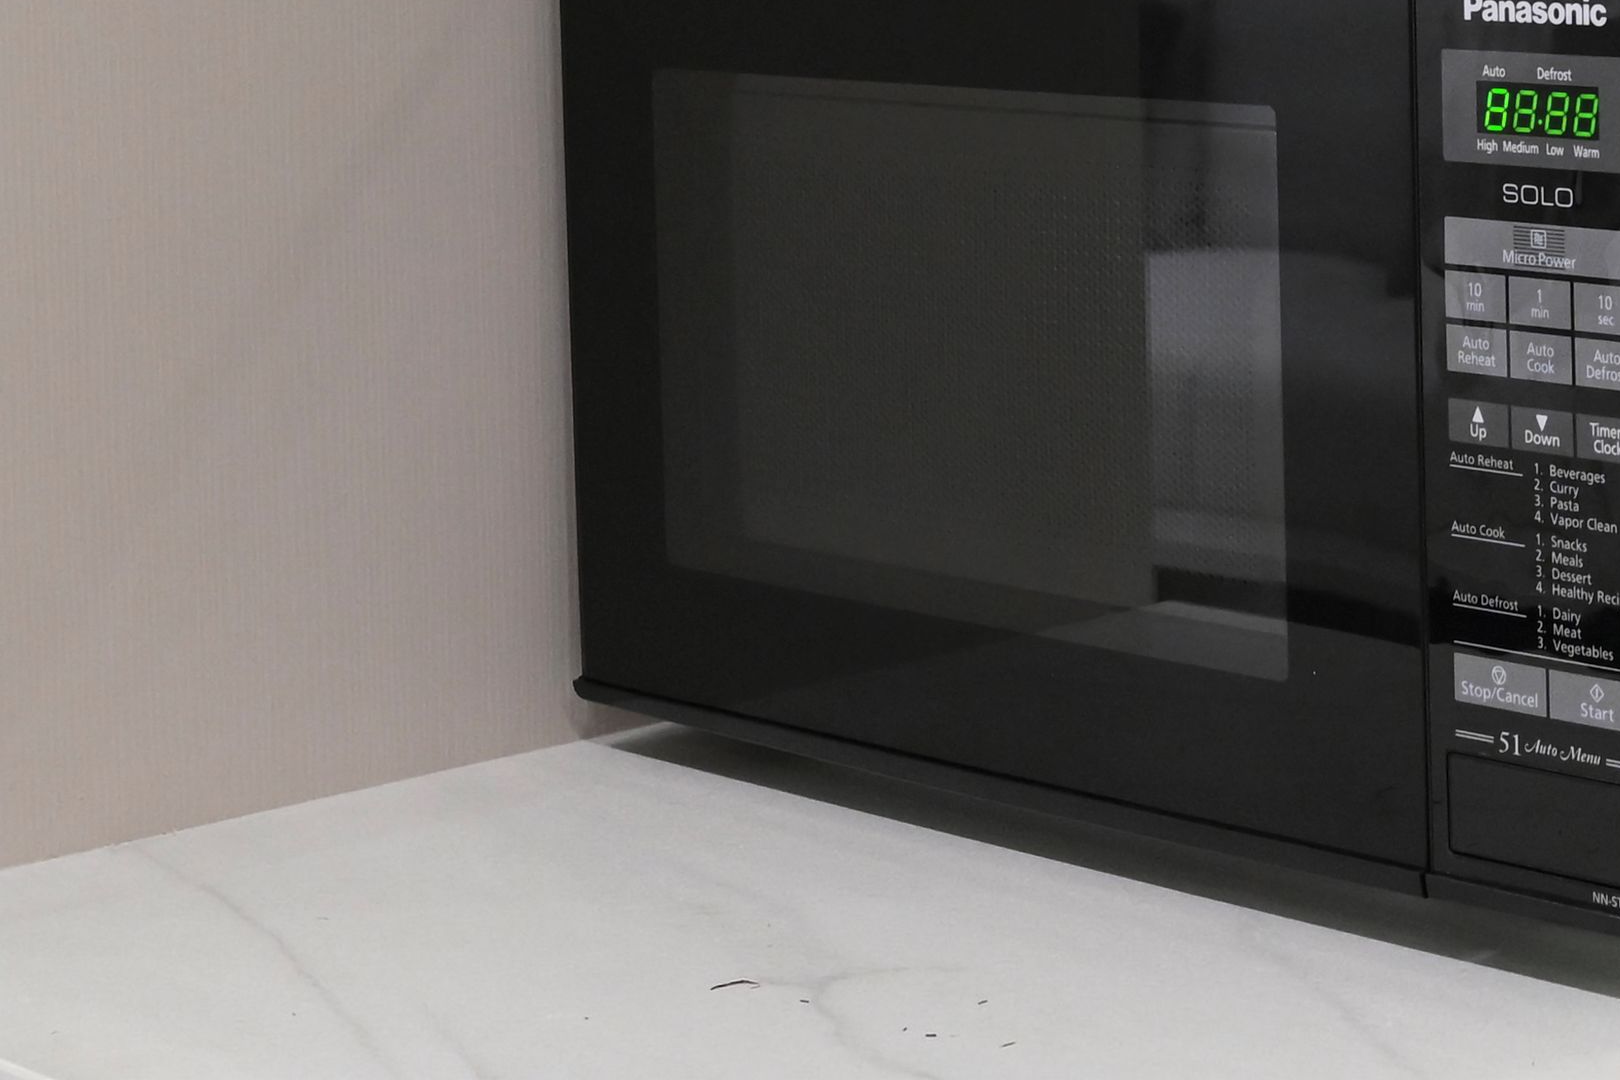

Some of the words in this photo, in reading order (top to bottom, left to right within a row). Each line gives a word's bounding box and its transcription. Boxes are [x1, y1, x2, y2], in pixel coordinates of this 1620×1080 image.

[1482, 64, 1506, 78] Auto
[1537, 67, 1572, 82] Defrost
[1477, 139, 1498, 155] High
[1503, 140, 1539, 154] Medium
[1546, 143, 1564, 156] Low
[1574, 145, 1600, 159] Warm
[1502, 183, 1574, 208] SOLO
[1502, 249, 1536, 266] Micro
[1539, 252, 1576, 269] Power
[1468, 282, 1482, 297] 10
[1536, 289, 1542, 303] 1
[1466, 300, 1485, 313] min
[1531, 306, 1549, 319] min
[1598, 295, 1612, 311] 10
[1598, 315, 1615, 327] sec
[1463, 335, 1490, 351] Auto
[1527, 342, 1554, 358] Auto
[1458, 351, 1496, 368] Reheat
[1527, 358, 1554, 374] Cook
[1593, 349, 1620, 365] Auto
[1469, 424, 1487, 441] Up
[1524, 429, 1560, 448] Down
[1450, 451, 1475, 466] Auto
[1477, 454, 1514, 471] Reheat
[1534, 463, 1543, 476] 1.
[1550, 465, 1606, 485] Beverages
[1534, 479, 1544, 492] 2.
[1550, 481, 1580, 499] Curry
[1534, 495, 1544, 508] 3.
[1550, 497, 1580, 512] Pasta
[1451, 520, 1477, 535] Auto
[1479, 524, 1505, 540] Cook
[1534, 510, 1544, 524] 4.
[1550, 513, 1584, 530] Vapor
[1587, 518, 1618, 534] Clean
[1536, 533, 1545, 546] 1.
[1551, 535, 1588, 553] Snacks
[1535, 549, 1545, 563] 2.
[1551, 552, 1584, 568] Meals
[1535, 565, 1546, 579] 3.
[1551, 568, 1593, 585] Dessert
[1453, 590, 1478, 605] Auto
[1481, 594, 1519, 611] Defrost
[1535, 581, 1546, 595] 4.
[1552, 584, 1594, 605] Healthy
[1537, 605, 1546, 618] 1.
[1552, 607, 1581, 626] Dairy
[1537, 620, 1546, 634] 2.
[1553, 623, 1582, 640] Meat
[1537, 636, 1547, 651] 3.
[1553, 640, 1614, 662] Vegetables
[1461, 680, 1538, 708] Stop/Cancel
[1580, 702, 1615, 722] Start
[1499, 731, 1521, 756] 51
[1524, 739, 1558, 757] Auto
[1560, 745, 1601, 765] Menu
